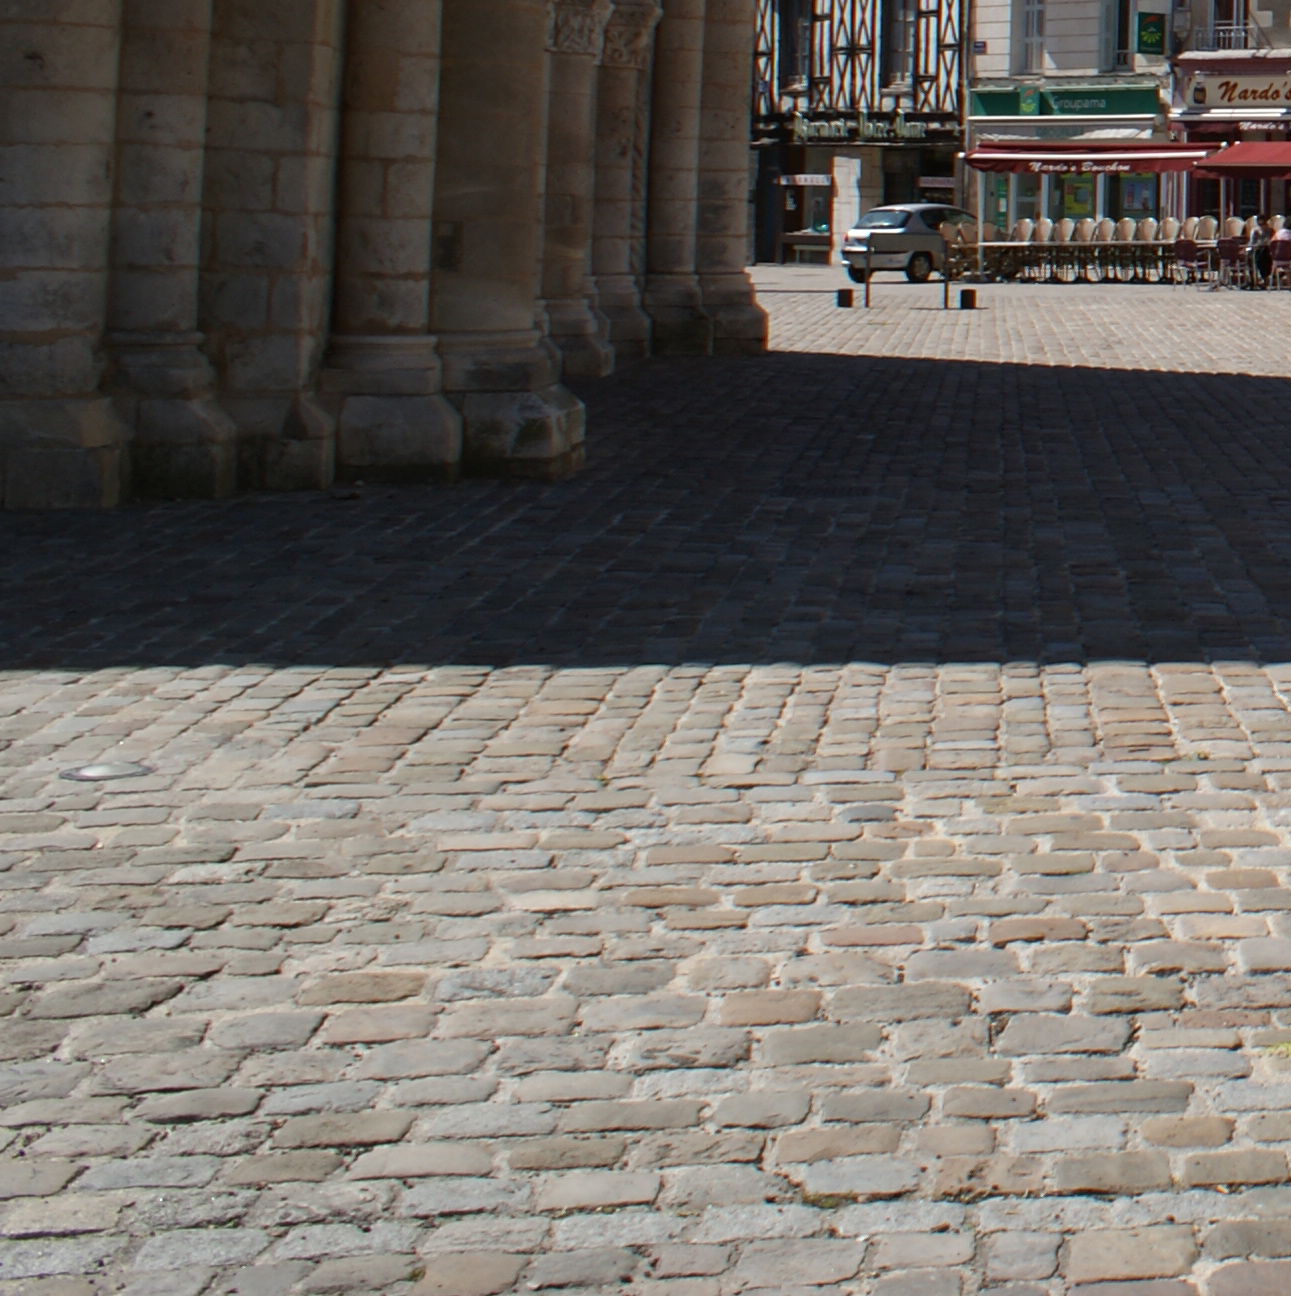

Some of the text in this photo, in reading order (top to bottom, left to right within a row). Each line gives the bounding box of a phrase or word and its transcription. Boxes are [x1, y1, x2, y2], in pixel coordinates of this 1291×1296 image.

[1052, 95, 1107, 112] Groupama
[1028, 161, 1131, 172] Nardo's Bouchon
